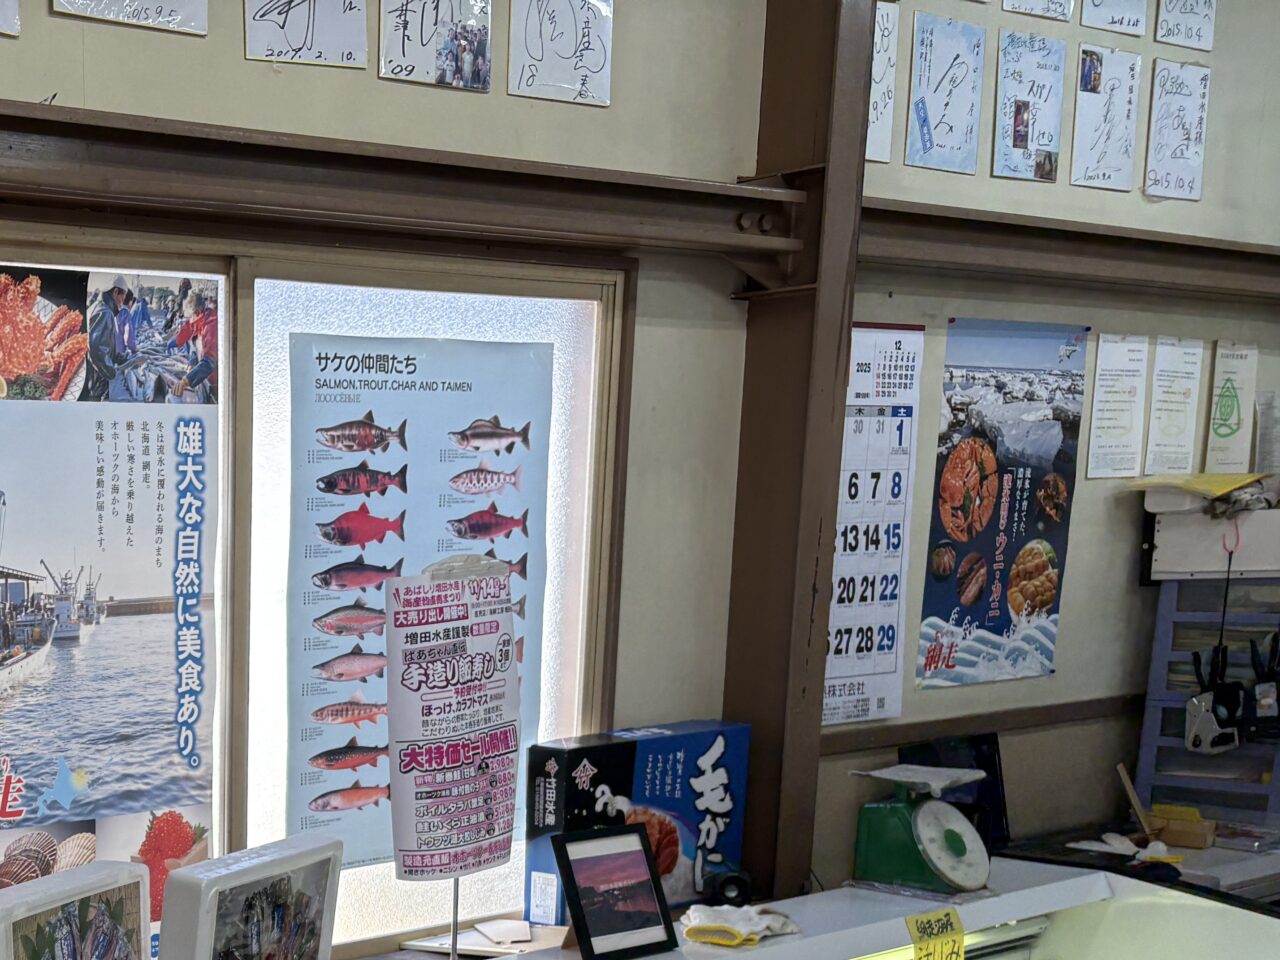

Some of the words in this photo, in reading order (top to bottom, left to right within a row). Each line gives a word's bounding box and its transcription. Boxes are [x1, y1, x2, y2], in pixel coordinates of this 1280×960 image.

[895, 340, 902, 350] 12
[315, 352, 418, 375] サケの仲間たち
[856, 363, 871, 373] 2025
[419, 381, 439, 391] AND
[441, 382, 472, 393] TAIMEN
[855, 407, 865, 416] 木
[897, 407, 907, 416] 土
[853, 419, 863, 434] 30
[876, 419, 885, 434] 31
[896, 419, 903, 446] 1
[110, 421, 120, 517] オホーツクの海から
[95, 420, 106, 553] 美味しい感動が届きます。
[125, 421, 136, 547] 厳しい寒さを乗り越えた
[848, 472, 859, 500] 6
[871, 472, 881, 499] 7
[891, 472, 902, 499] 8
[841, 525, 859, 552] 13
[863, 524, 880, 551] 14
[884, 523, 901, 550] 15
[174, 420, 204, 768] 雄大な自然に美食あり。
[837, 577, 855, 604] 20
[859, 576, 876, 603] 21
[879, 574, 898, 601] 22
[834, 628, 852, 655] 27
[856, 626, 873, 653] 28
[877, 625, 895, 651] 29
